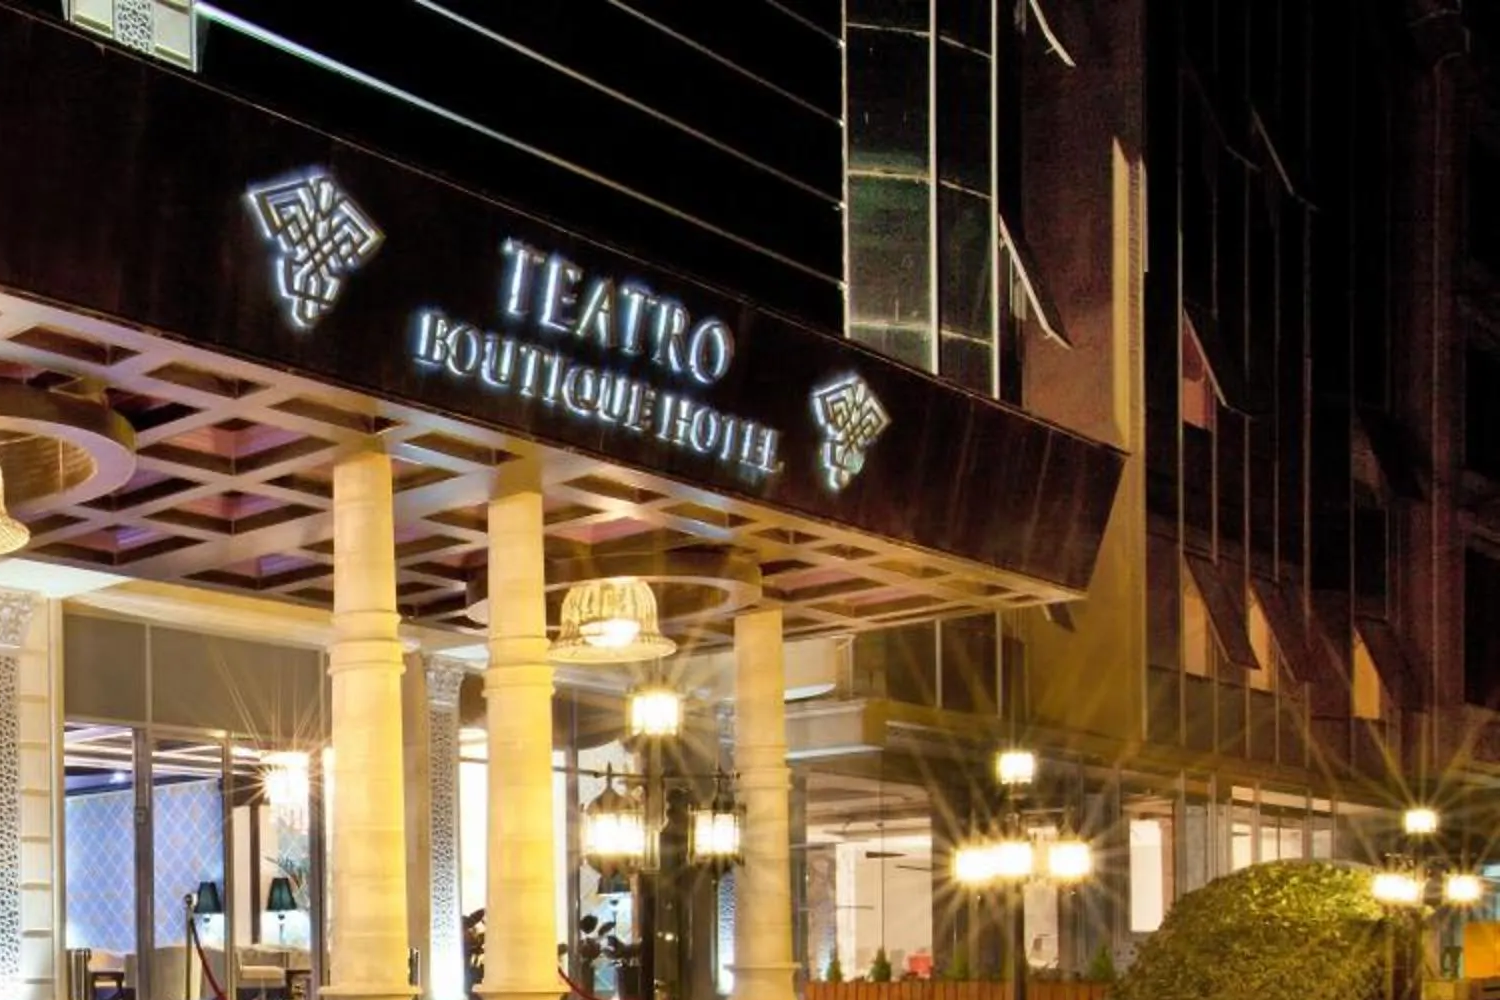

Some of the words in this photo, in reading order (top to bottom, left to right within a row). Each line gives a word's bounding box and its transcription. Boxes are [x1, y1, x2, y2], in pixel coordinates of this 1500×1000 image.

[503, 238, 735, 384] TEATRO
[414, 310, 655, 431] BOUTIQUE
[657, 394, 785, 473] HOTEL
